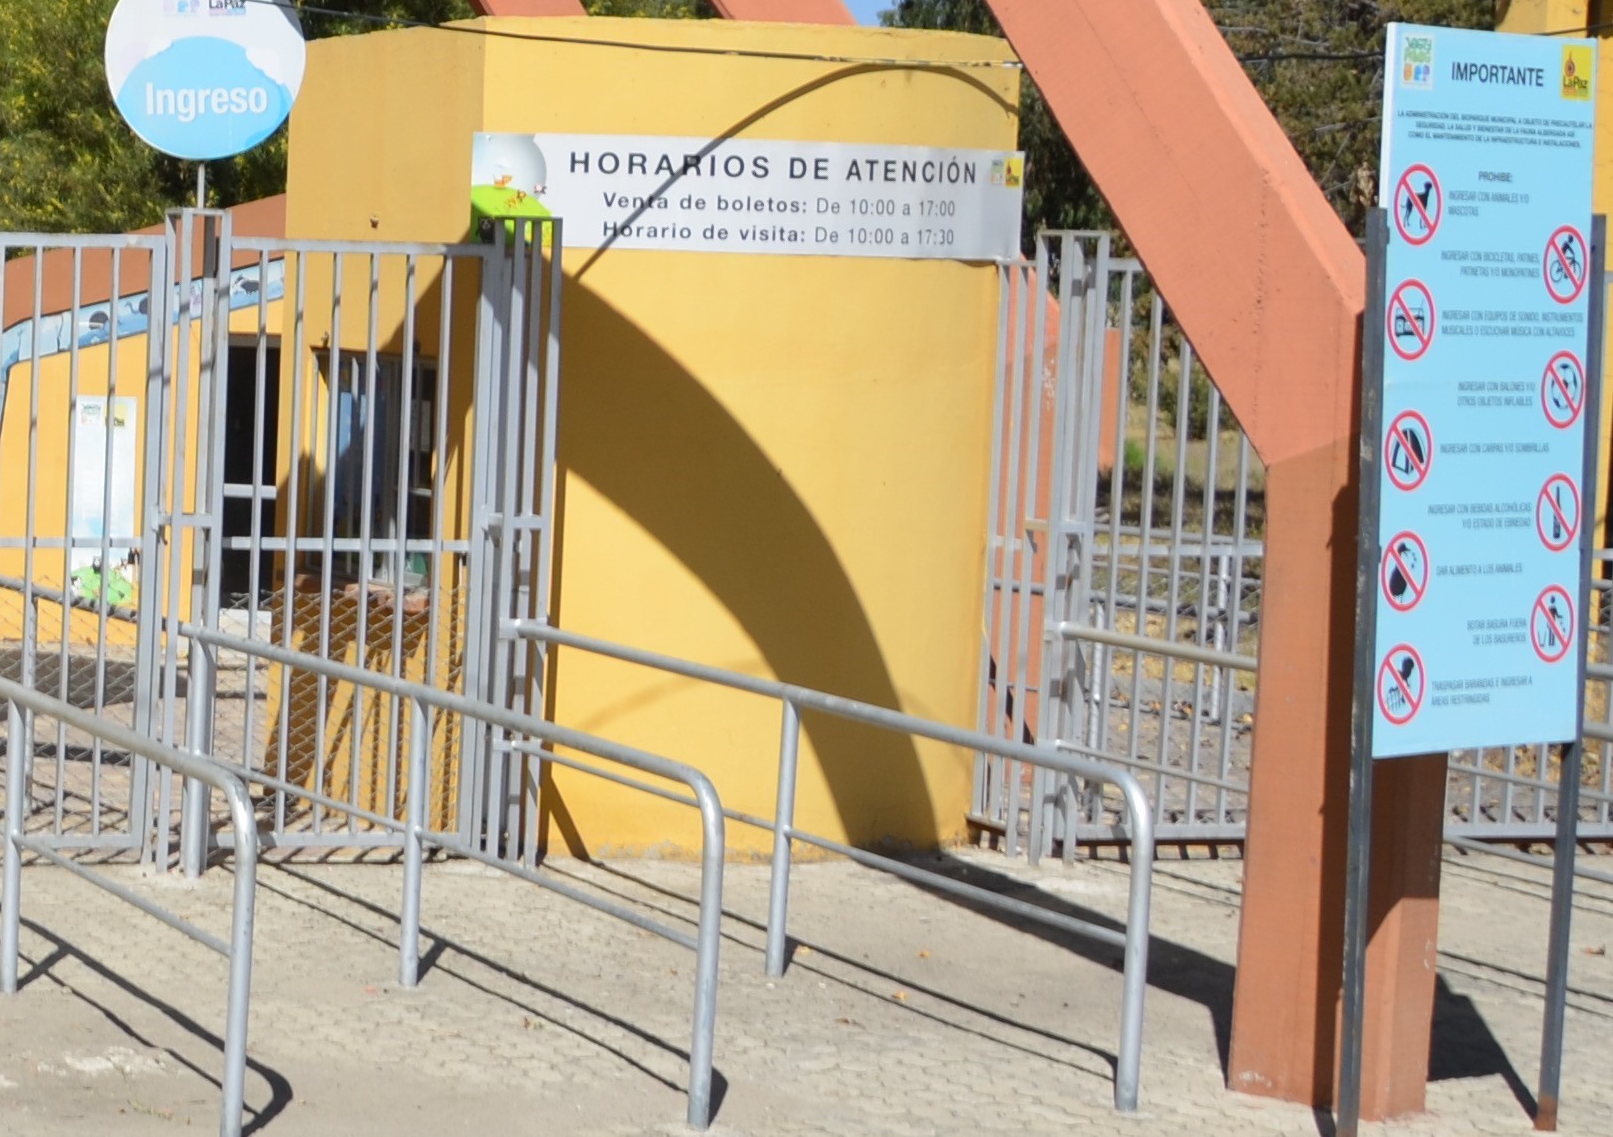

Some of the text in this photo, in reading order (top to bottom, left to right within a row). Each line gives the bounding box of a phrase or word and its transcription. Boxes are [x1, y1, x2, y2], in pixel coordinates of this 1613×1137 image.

[1451, 61, 1544, 87] IMPORTANTE
[145, 82, 268, 123] Ingreso
[569, 151, 770, 179] HORARIOS
[789, 157, 829, 180] DE
[845, 155, 976, 184] ATENCIÓN
[603, 192, 955, 217] Venta de boletos: De 10:00 a 17:00
[603, 221, 954, 245] Horario de visita: De 10:00 a 17:30
